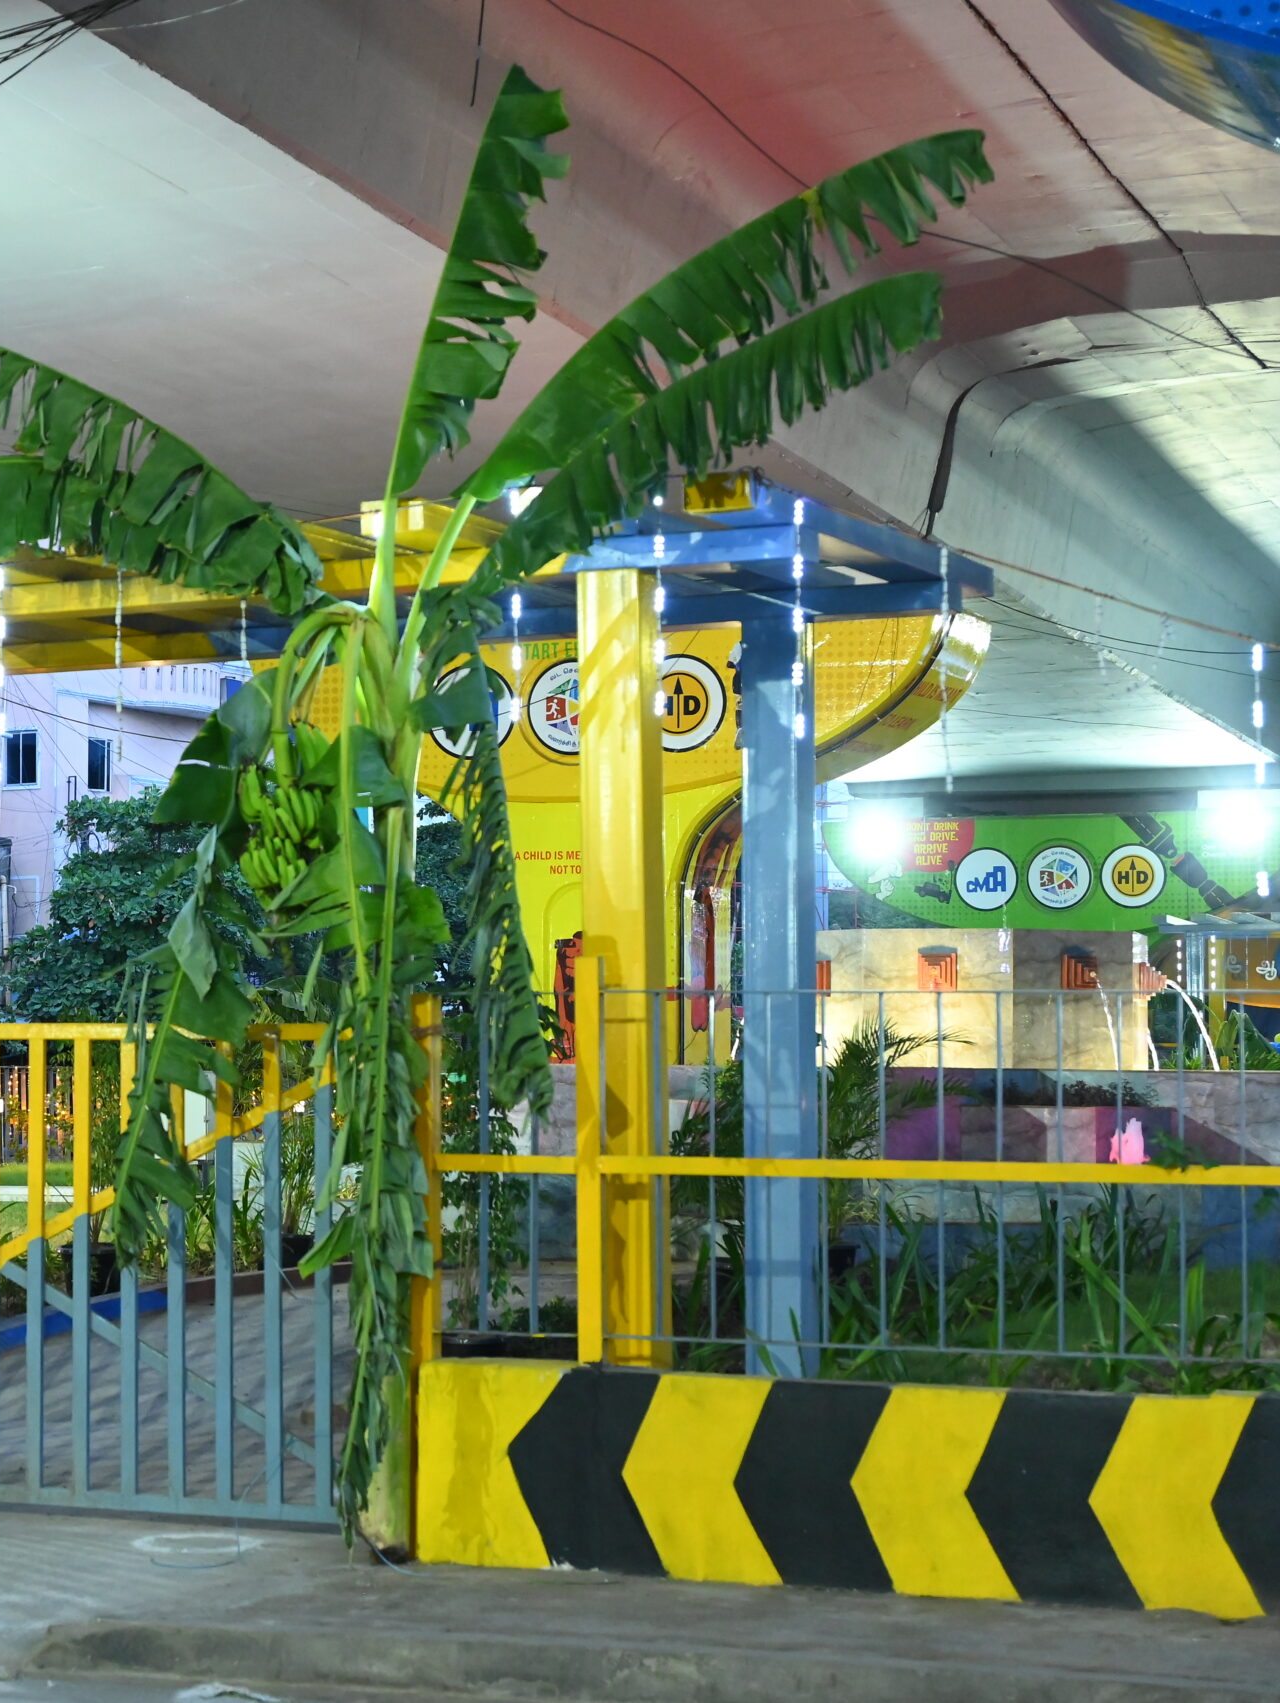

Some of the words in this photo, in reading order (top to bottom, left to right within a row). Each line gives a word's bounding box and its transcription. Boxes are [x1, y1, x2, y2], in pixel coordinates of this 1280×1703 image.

[521, 642, 560, 660] TART
[933, 821, 960, 831] DRINK
[914, 843, 949, 854] ARRIVE
[514, 851, 521, 860] A
[523, 851, 552, 860] CHILD
[554, 851, 563, 860] IS
[565, 851, 581, 860] ME
[916, 855, 944, 866] ALIVE
[549, 865, 568, 874] NOT
[570, 865, 582, 874] TO
